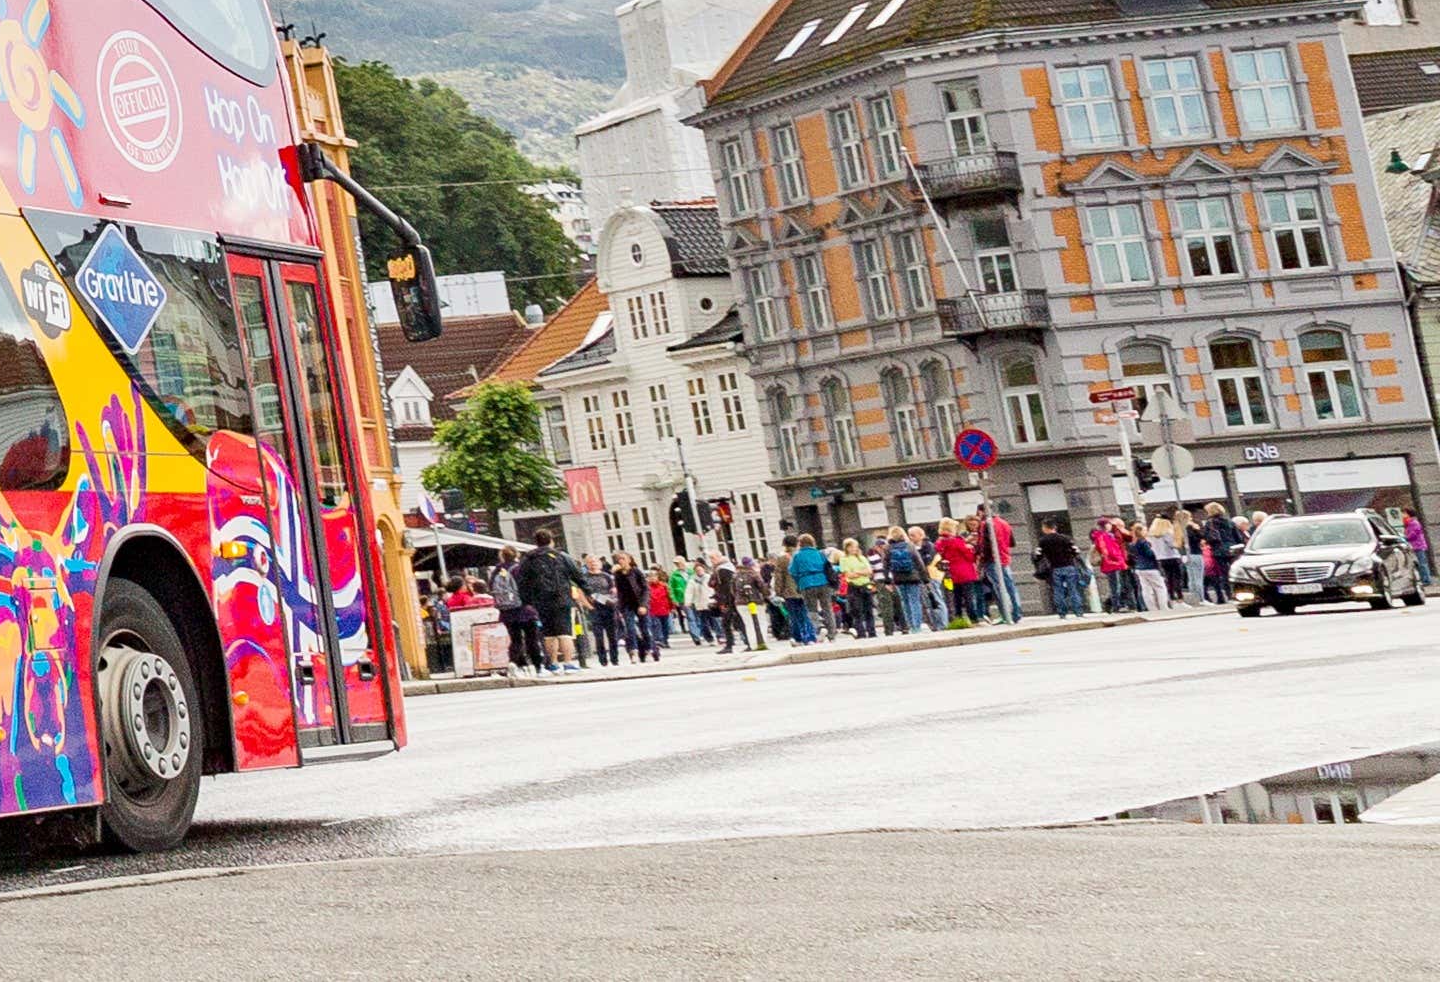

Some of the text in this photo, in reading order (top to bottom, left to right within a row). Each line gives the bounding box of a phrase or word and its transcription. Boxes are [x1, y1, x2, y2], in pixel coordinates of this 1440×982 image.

[113, 39, 141, 58] TOUR
[114, 85, 166, 116] OFFICIAL
[205, 85, 277, 144] Hop On
[1245, 441, 1280, 463] DNB
